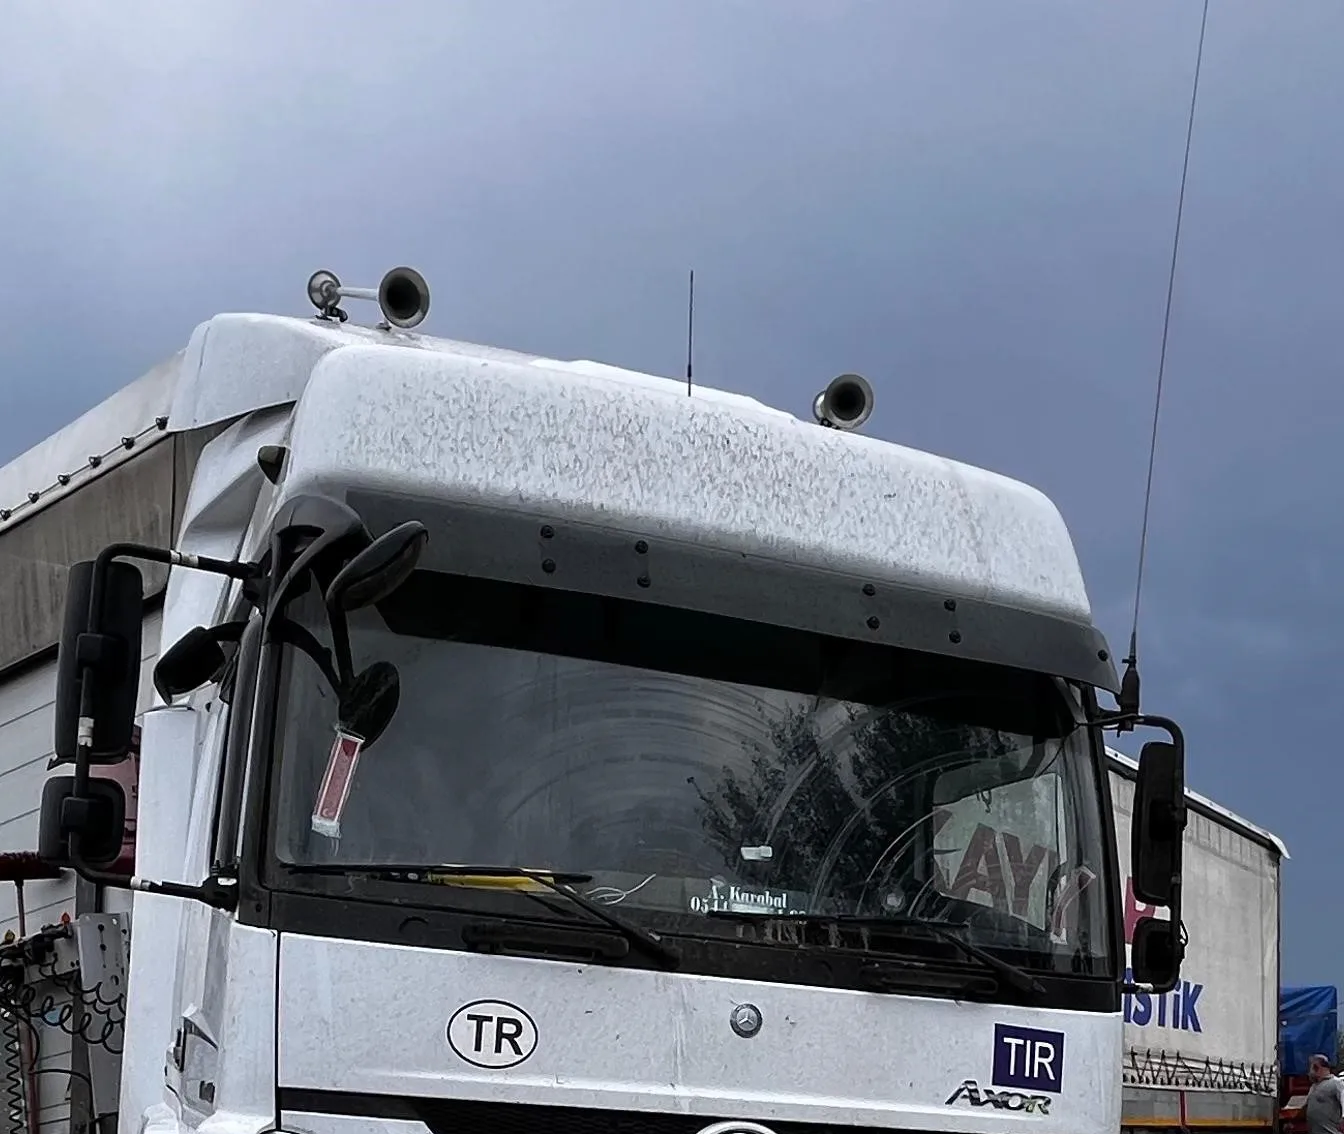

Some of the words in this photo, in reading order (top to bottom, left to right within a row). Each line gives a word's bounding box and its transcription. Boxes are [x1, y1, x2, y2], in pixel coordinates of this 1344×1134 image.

[466, 1013, 524, 1056] TR
[1002, 1036, 1056, 1080] TIR
[944, 1079, 1052, 1115] AXOR
